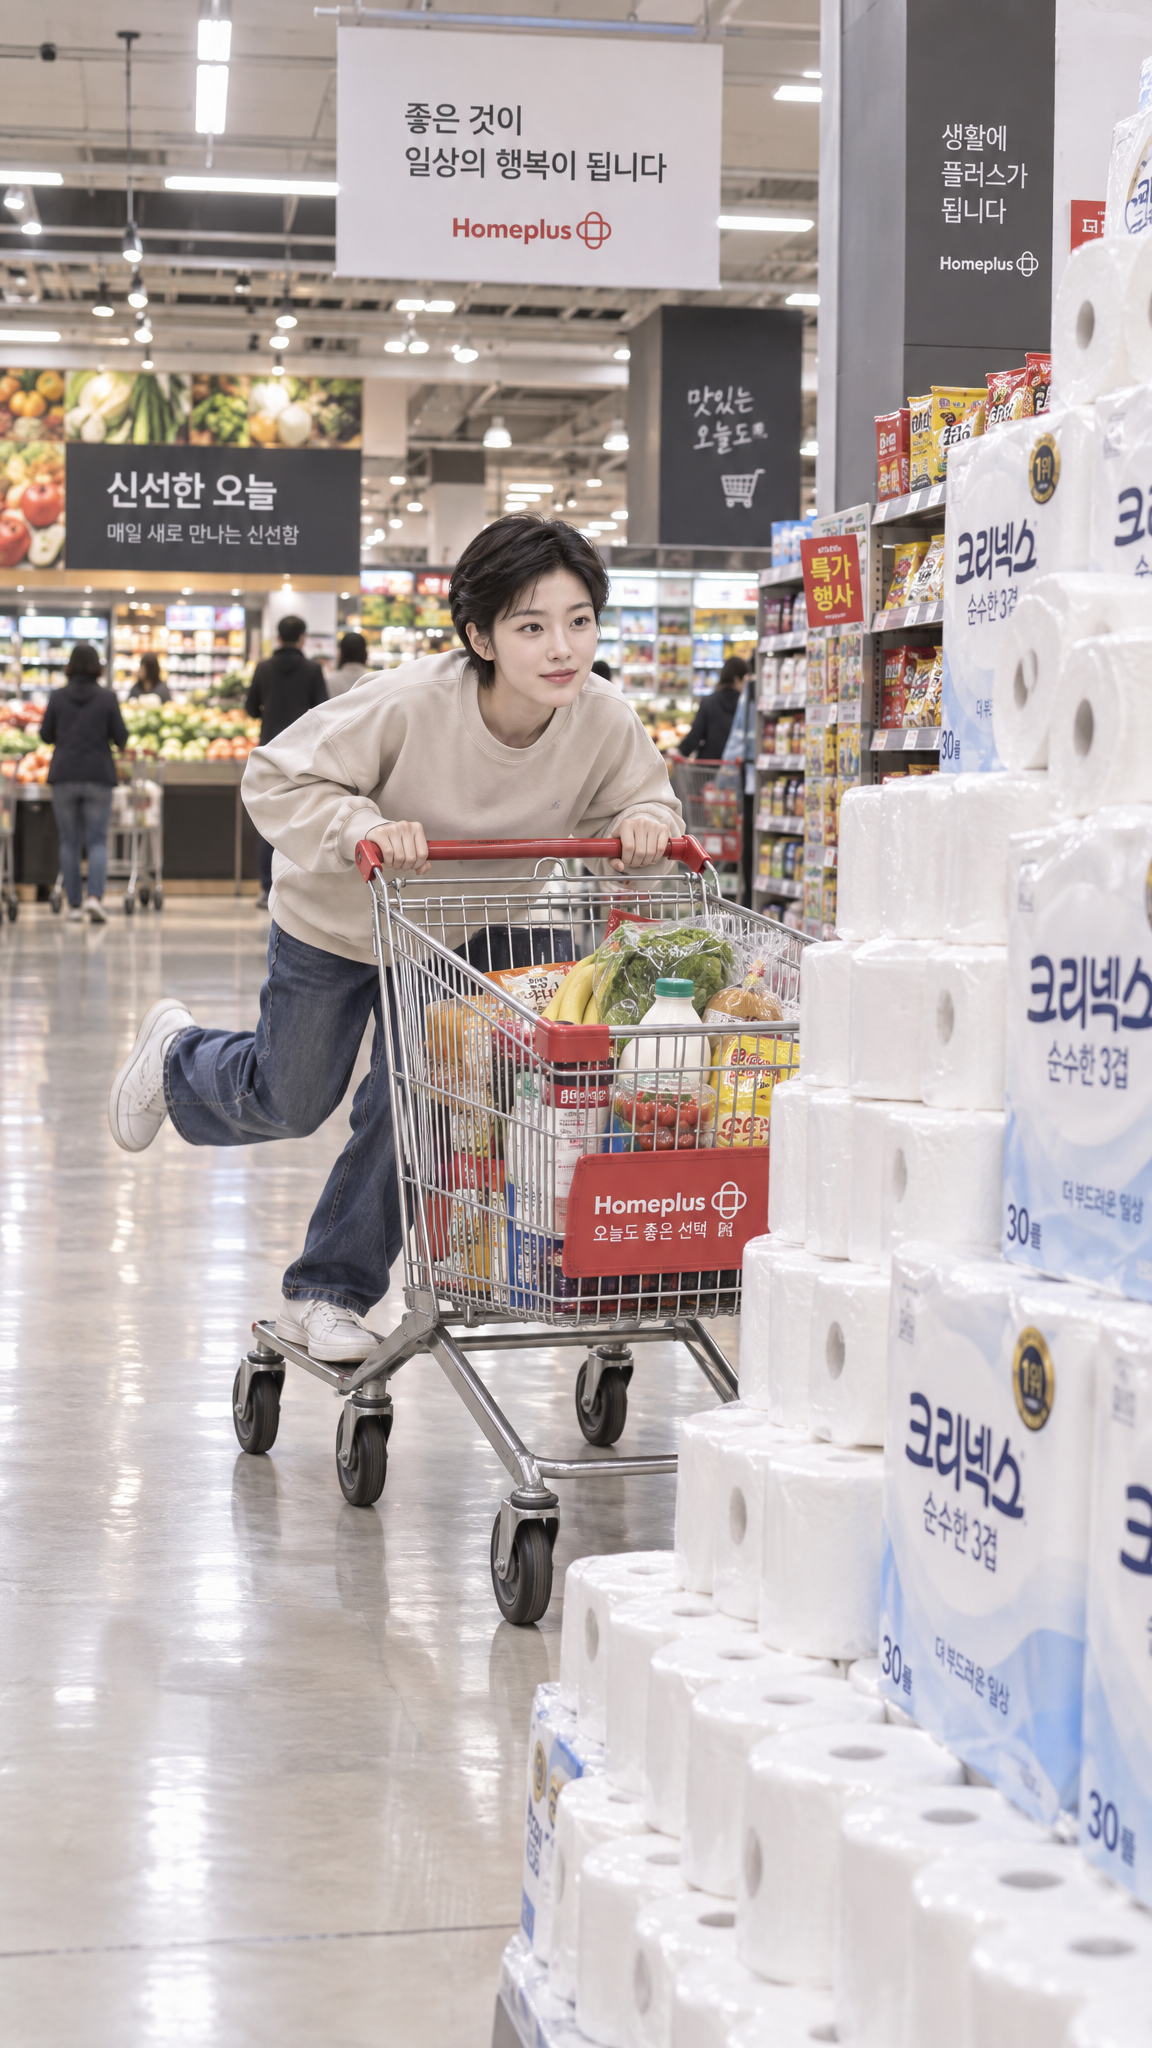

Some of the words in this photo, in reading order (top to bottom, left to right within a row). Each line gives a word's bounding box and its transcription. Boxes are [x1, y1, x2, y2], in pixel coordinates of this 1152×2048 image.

[405, 102, 460, 135] 좋은
[469, 104, 522, 137] 것이
[941, 123, 1007, 152] 생활에
[405, 146, 485, 179] 일상의
[496, 148, 576, 181] 행복이
[586, 151, 668, 184] 됩니다
[941, 160, 1028, 189] 플러스가
[941, 196, 1006, 225] 됩니다
[452, 217, 572, 245] Homeplus
[939, 255, 1014, 275] Homeplus
[687, 385, 754, 418] 맛있는
[106, 471, 206, 509] 신선한
[212, 473, 278, 511] 오늘
[1114, 486, 1152, 547] 크
[107, 522, 142, 544] 매일
[147, 523, 184, 544] 새로
[189, 523, 242, 545] 만나는
[247, 524, 300, 546] 신선함
[811, 554, 852, 583] 특가
[955, 518, 1037, 585] 크리넥스
[812, 583, 854, 612] 행사
[967, 590, 998, 625] 순수한
[1027, 955, 1152, 1031] 크리넥스
[1047, 1040, 1096, 1087] 순수한
[1099, 1045, 1128, 1091] 3겹
[594, 1192, 706, 1218] Homeplus
[1062, 1180, 1073, 1208] 더
[1075, 1183, 1117, 1219] 부드러운
[593, 1224, 639, 1242] 오늘도
[677, 1220, 707, 1240] 선택
[905, 1391, 1025, 1520] 크리넥스
[923, 1491, 969, 1555] 순수한
[971, 1518, 998, 1574] 3겹
